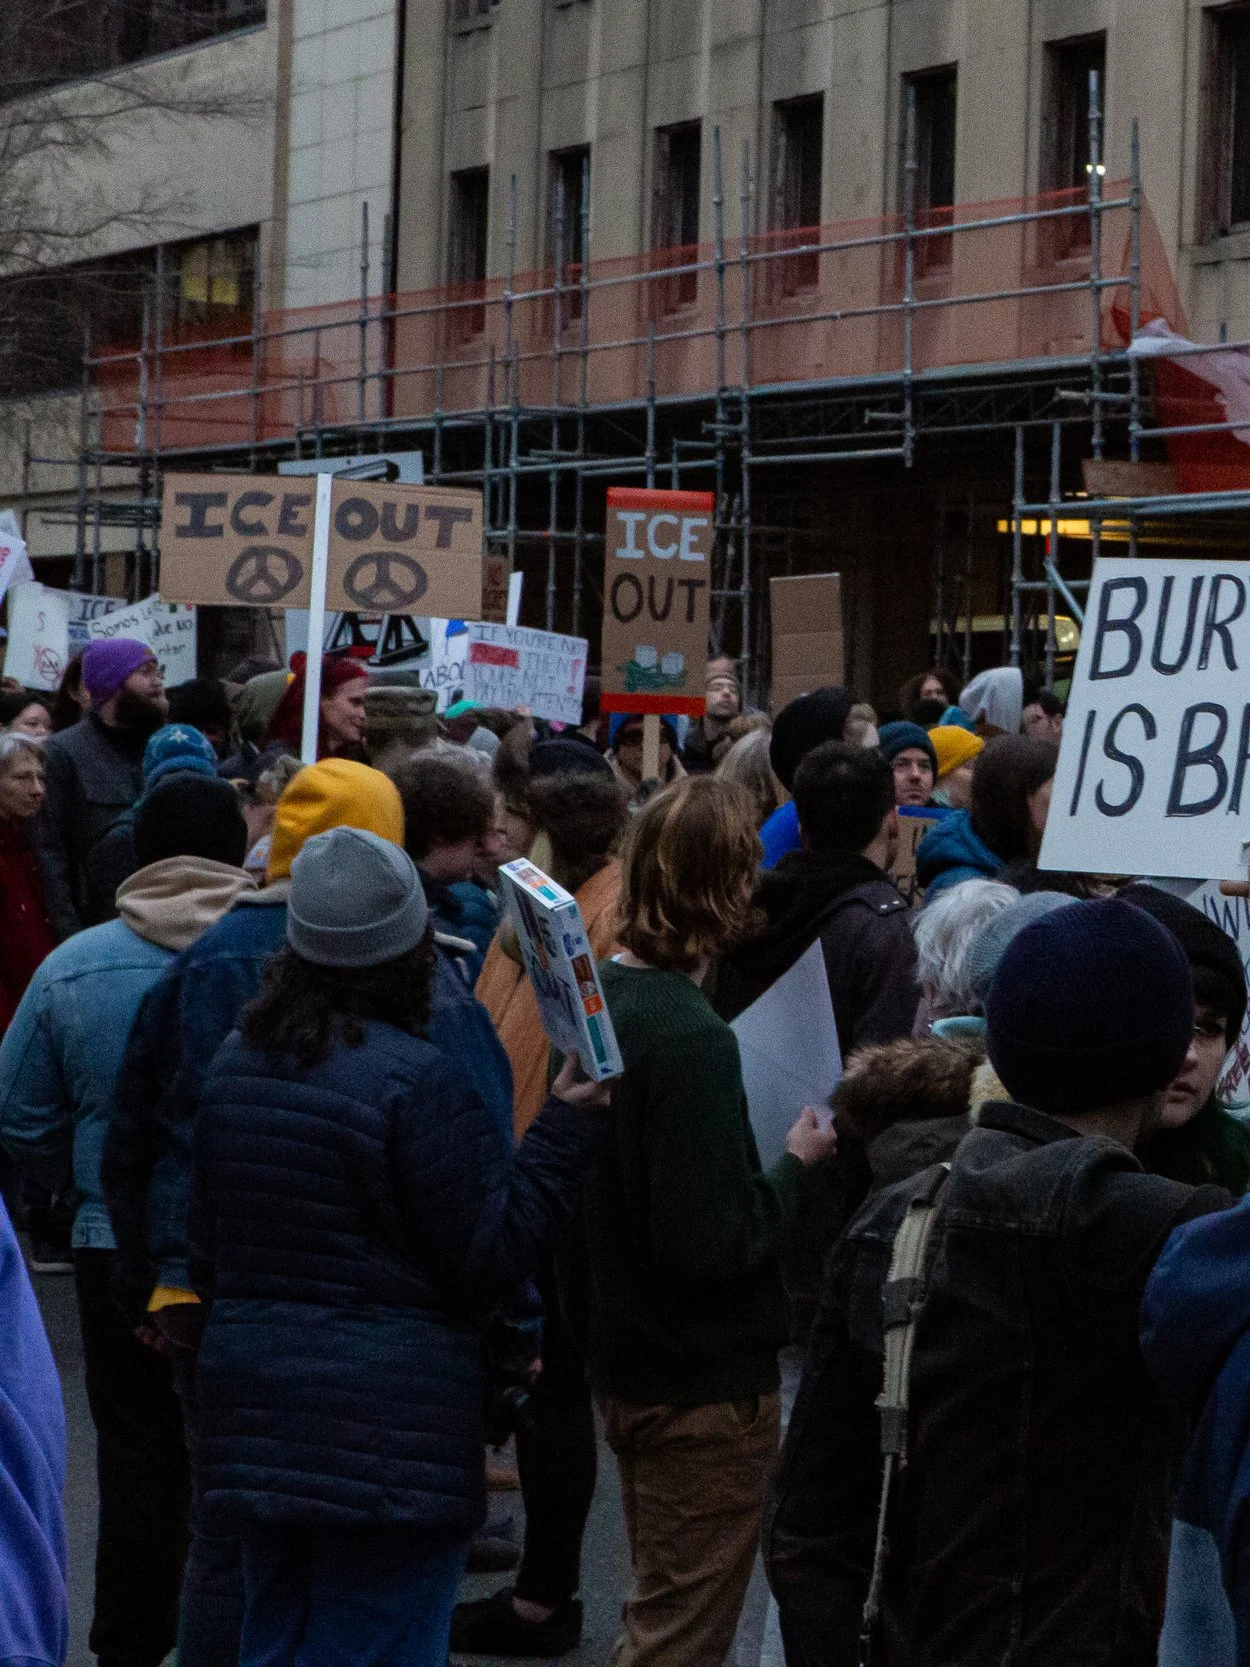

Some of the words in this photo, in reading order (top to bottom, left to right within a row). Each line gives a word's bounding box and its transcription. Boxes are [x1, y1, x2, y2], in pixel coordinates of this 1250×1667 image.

[174, 491, 312, 539] ICE
[334, 497, 473, 549] OUT
[615, 512, 708, 561] ICE
[610, 572, 706, 624] OUT
[1069, 703, 1157, 816] IS
